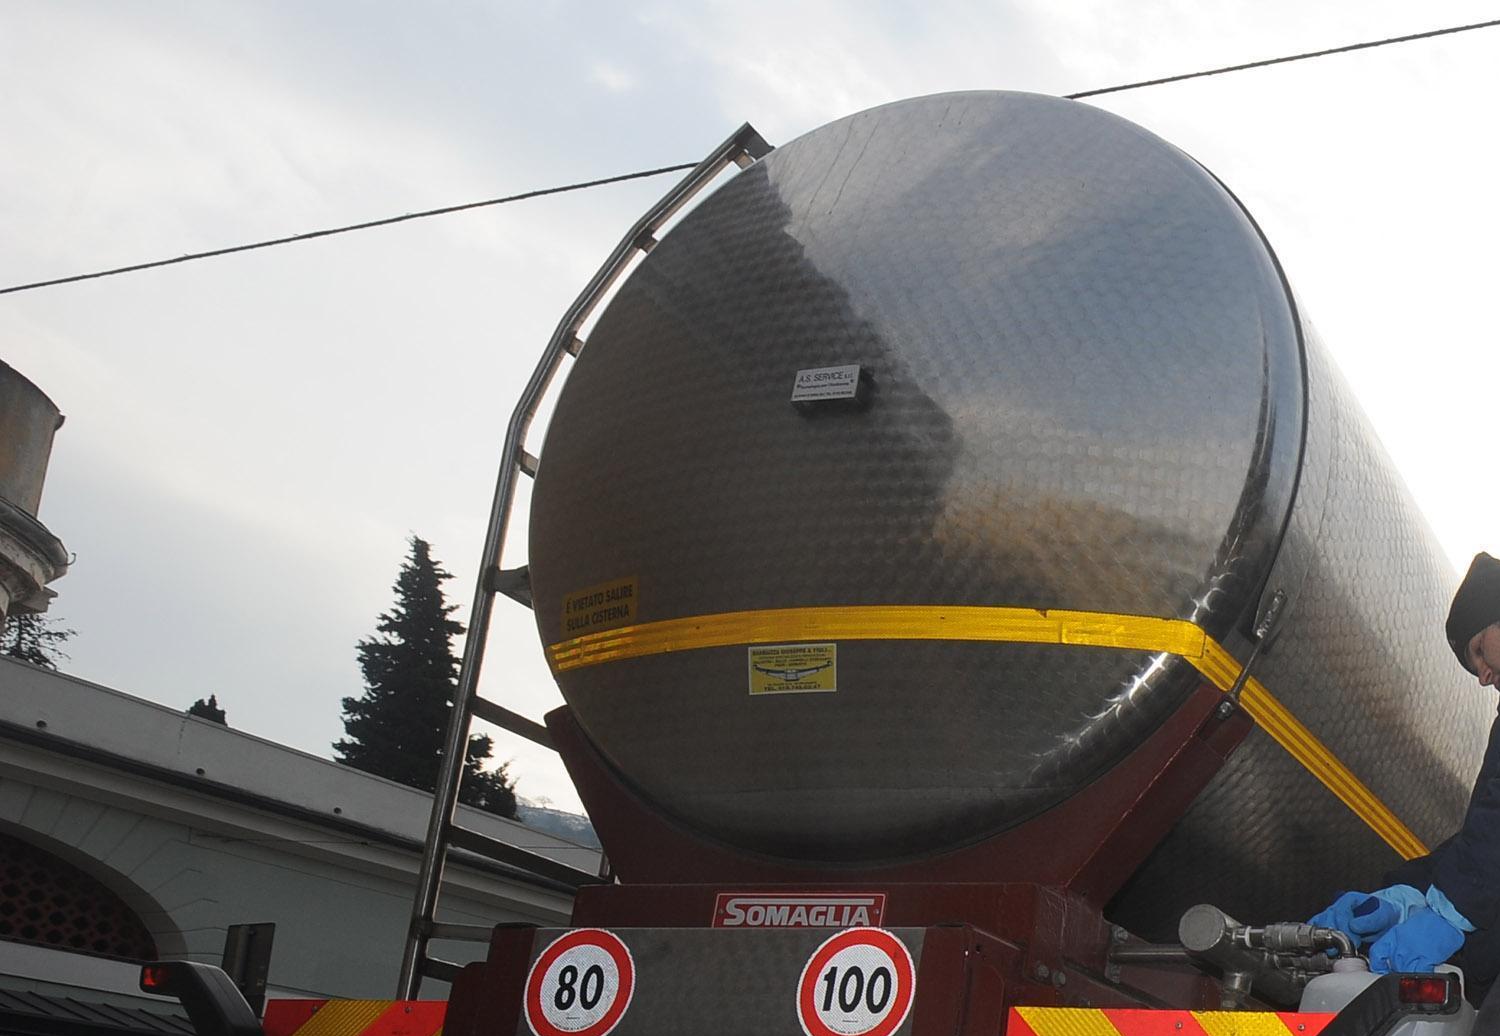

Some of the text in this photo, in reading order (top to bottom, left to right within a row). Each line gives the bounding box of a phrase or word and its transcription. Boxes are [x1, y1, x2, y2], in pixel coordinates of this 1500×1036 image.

[813, 371, 844, 382] SERVICE
[572, 591, 604, 611] VIETATO
[605, 583, 633, 602] SALIRE
[566, 603, 630, 632] SULLA CISTERNA
[723, 898, 875, 927] SOMAGLIA
[553, 963, 605, 1011] 80
[822, 965, 893, 1014] 100
